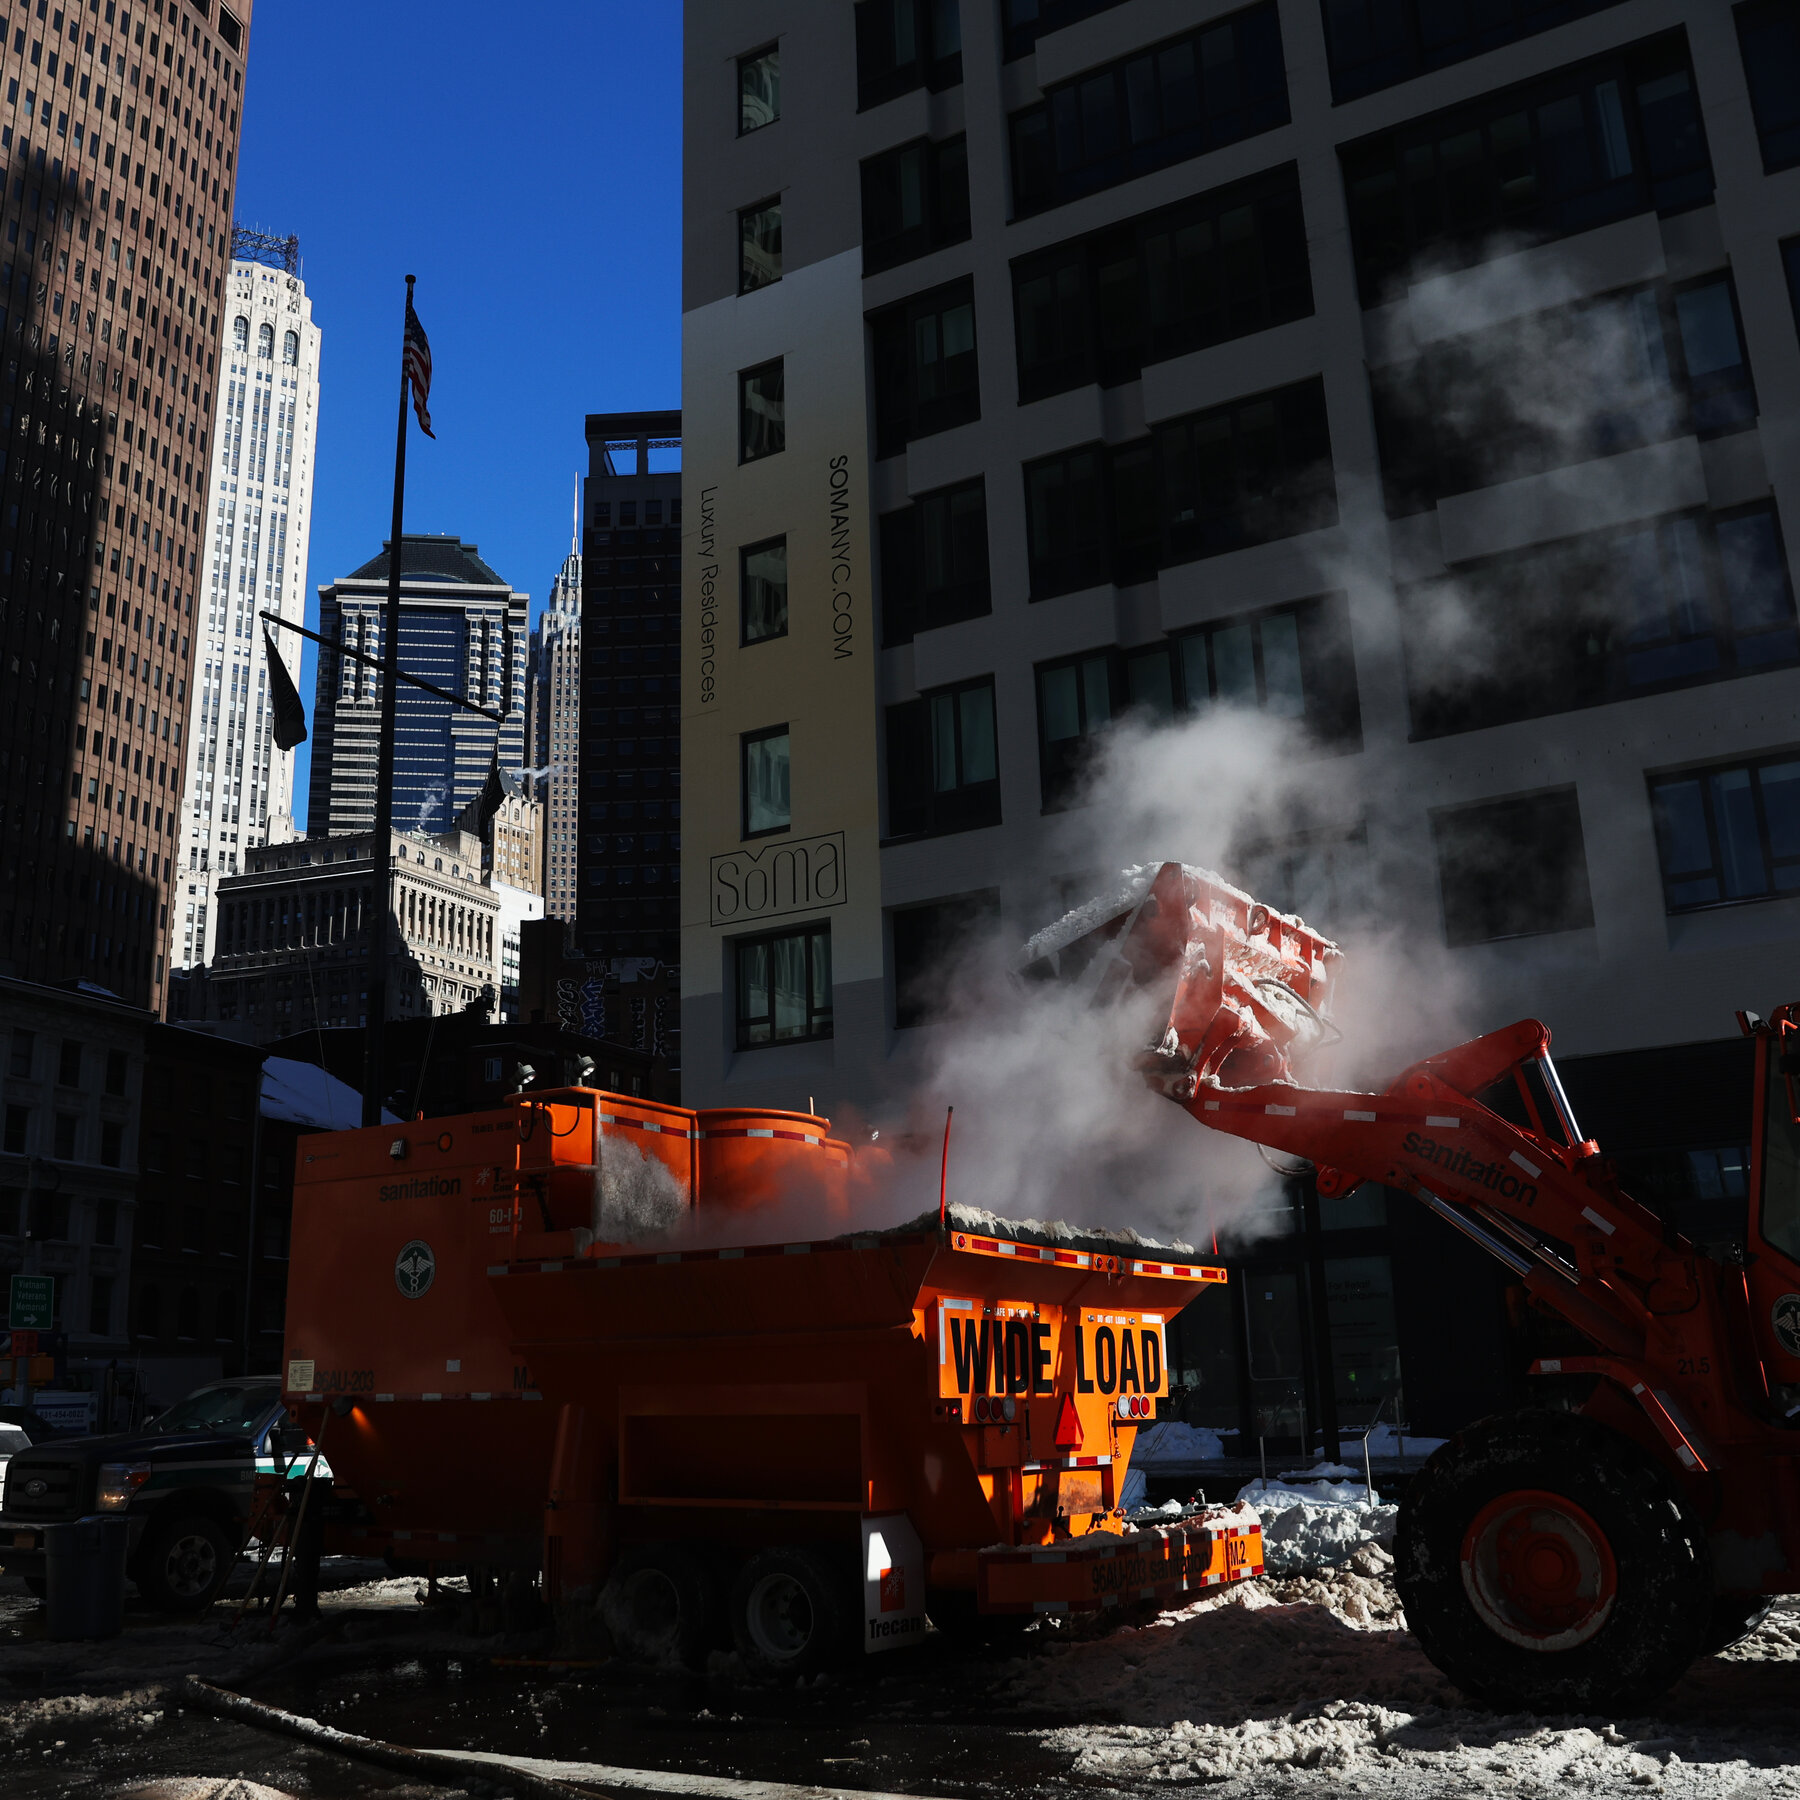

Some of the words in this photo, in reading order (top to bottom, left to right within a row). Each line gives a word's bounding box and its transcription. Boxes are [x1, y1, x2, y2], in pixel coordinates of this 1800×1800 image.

[697, 486, 719, 557] Luxury
[829, 455, 853, 660] SOMANYC.COM
[700, 564, 719, 703] Residences
[1402, 1131, 1539, 1207] sanitation
[379, 1175, 461, 1202] sanitation
[17, 1290, 47, 1301] Veterans
[18, 1279, 47, 1289] Vietnam
[15, 1301, 47, 1312] Memorial
[949, 1317, 1054, 1394] WIDE
[1074, 1325, 1162, 1394] LOAD
[1678, 1357, 1711, 1375] 21.5
[1229, 1540, 1247, 1567] M.2
[1091, 1556, 1146, 1594] 96AU-203
[1150, 1549, 1210, 1581] sanitation
[869, 1616, 921, 1639] Trecan
